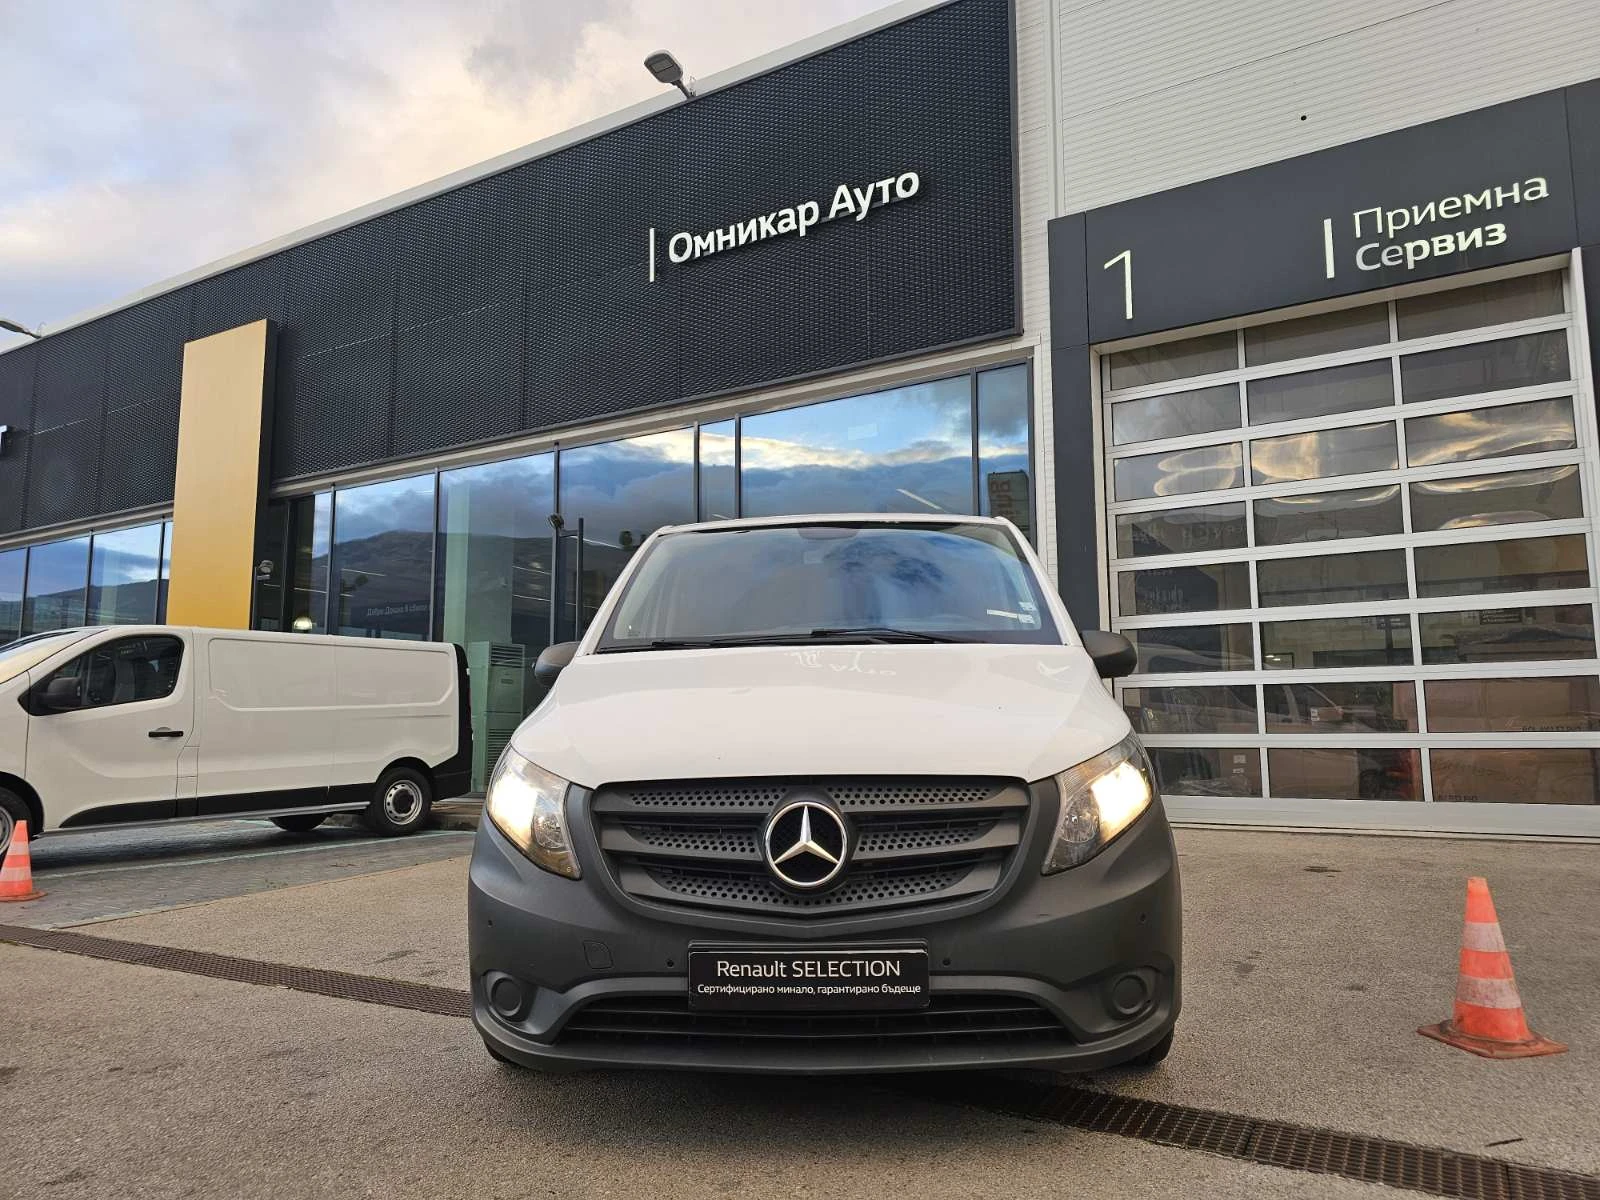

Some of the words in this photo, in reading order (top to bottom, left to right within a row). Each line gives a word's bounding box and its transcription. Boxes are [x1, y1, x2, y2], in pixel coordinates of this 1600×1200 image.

[668, 201, 819, 264] Омникар
[829, 171, 920, 221] Ауто
[1353, 176, 1550, 238] Приемна
[1355, 222, 1508, 271] Сервиз
[1104, 249, 1134, 320] 1
[697, 983, 775, 996] Сертифицирано
[776, 985, 816, 995] минало,
[817, 984, 880, 995] гарантирано
[881, 982, 921, 995] бъдеще
[717, 960, 787, 978] Renault
[792, 960, 902, 978] SELECTION
